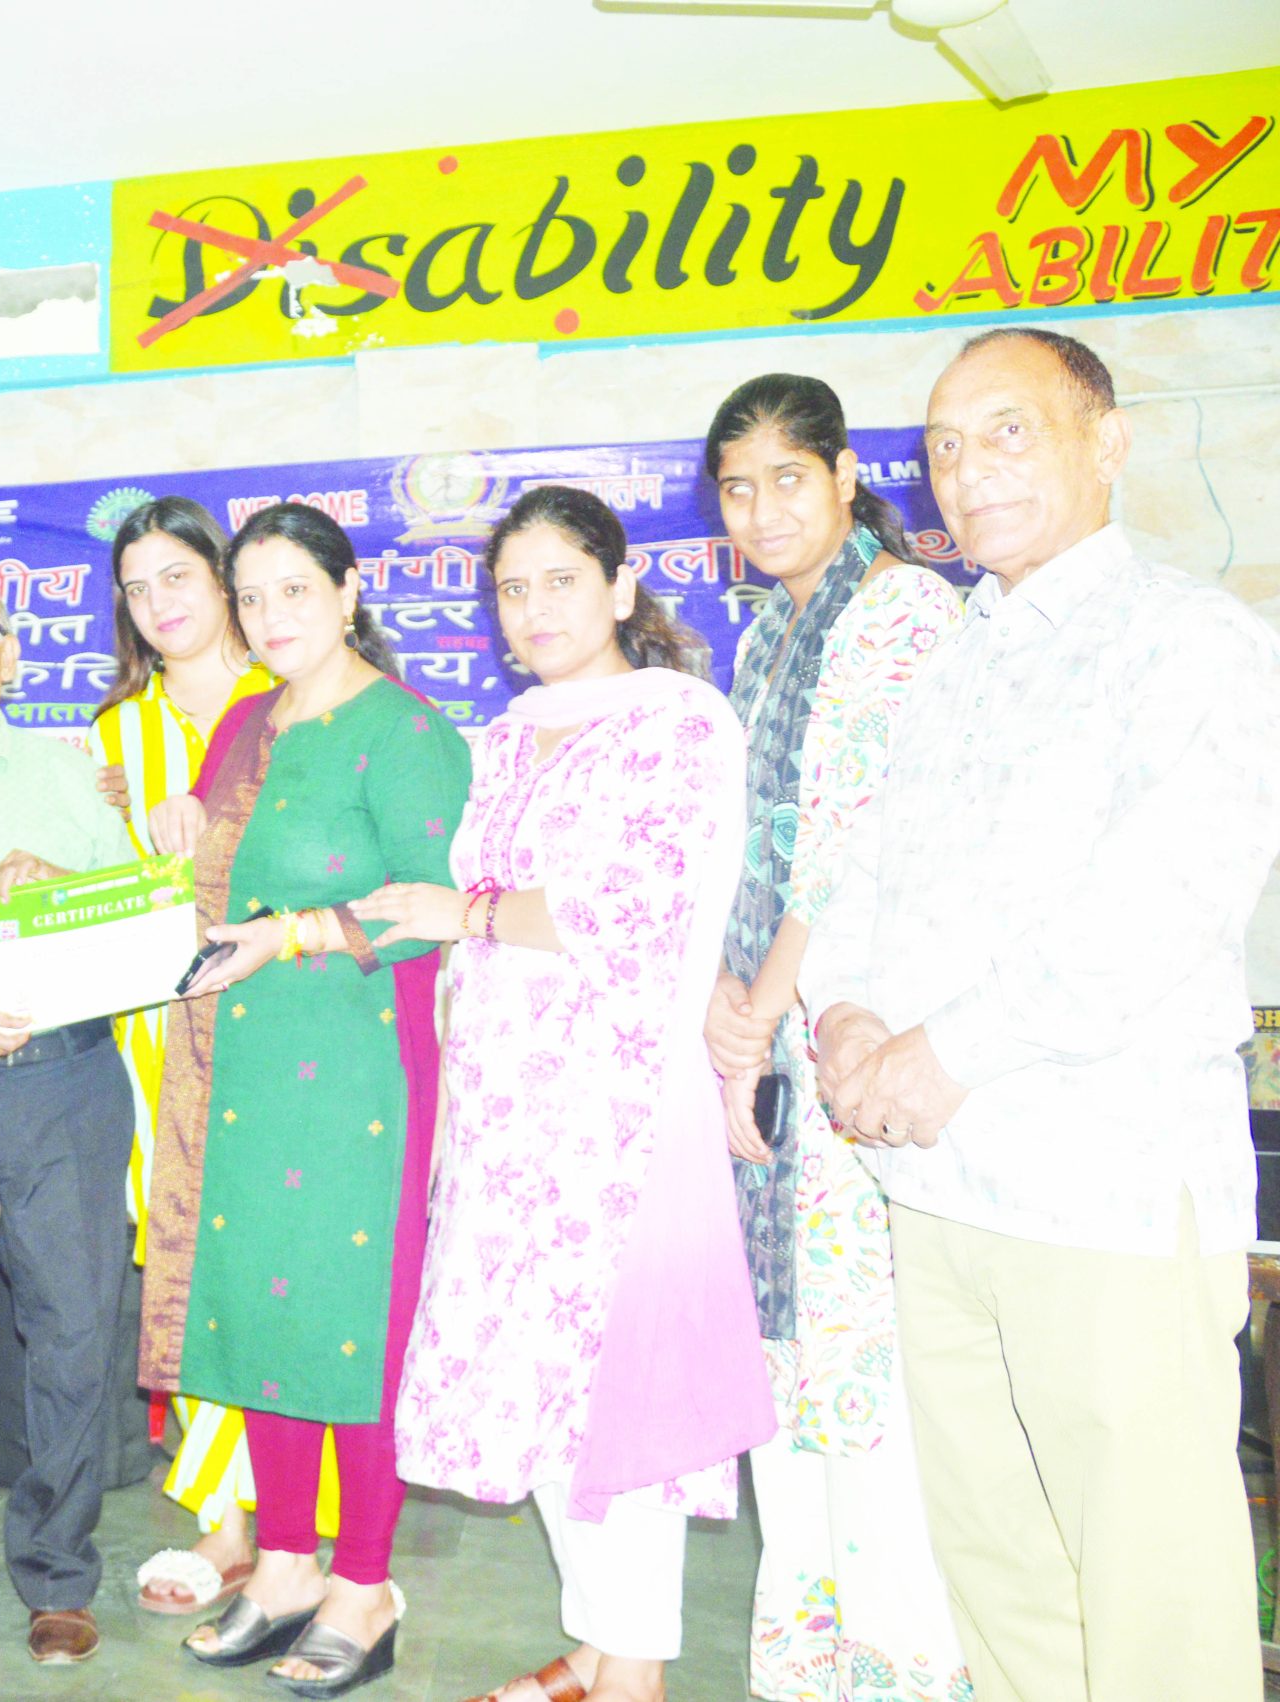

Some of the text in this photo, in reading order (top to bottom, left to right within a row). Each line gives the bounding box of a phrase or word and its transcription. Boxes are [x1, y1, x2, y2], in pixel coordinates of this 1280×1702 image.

[996, 116, 1276, 223] MY
[147, 144, 905, 319] Disability
[913, 208, 1280, 312] ABILIT
[227, 491, 368, 532] WEOME
[32, 894, 146, 929] CERTIFICATE
